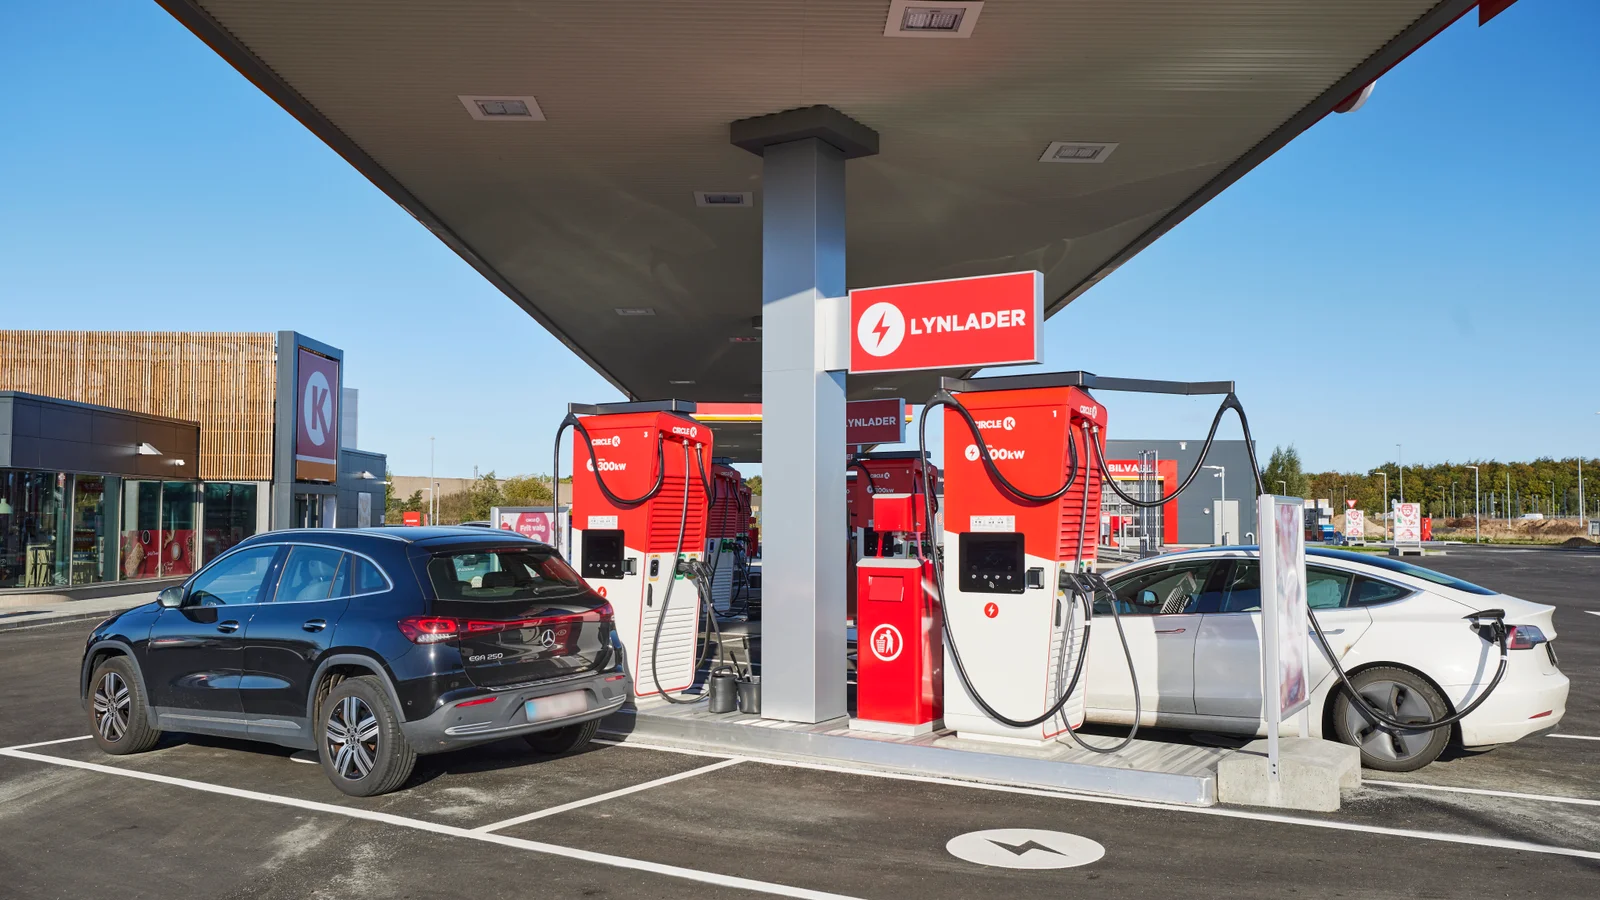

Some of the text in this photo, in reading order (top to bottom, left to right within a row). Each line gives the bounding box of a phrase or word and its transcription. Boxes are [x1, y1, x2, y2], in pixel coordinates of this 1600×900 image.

[910, 309, 1026, 335] LYNLADER
[310, 383, 330, 441] K
[1052, 410, 1057, 418] 1
[846, 416, 896, 428] YNLADER
[1003, 417, 1015, 430] K
[672, 426, 690, 435] CIRCLE
[591, 438, 611, 446] CIRCLE
[982, 448, 1025, 461] 00kW
[520, 524, 546, 533] Frit valg
[487, 652, 504, 660] 250
